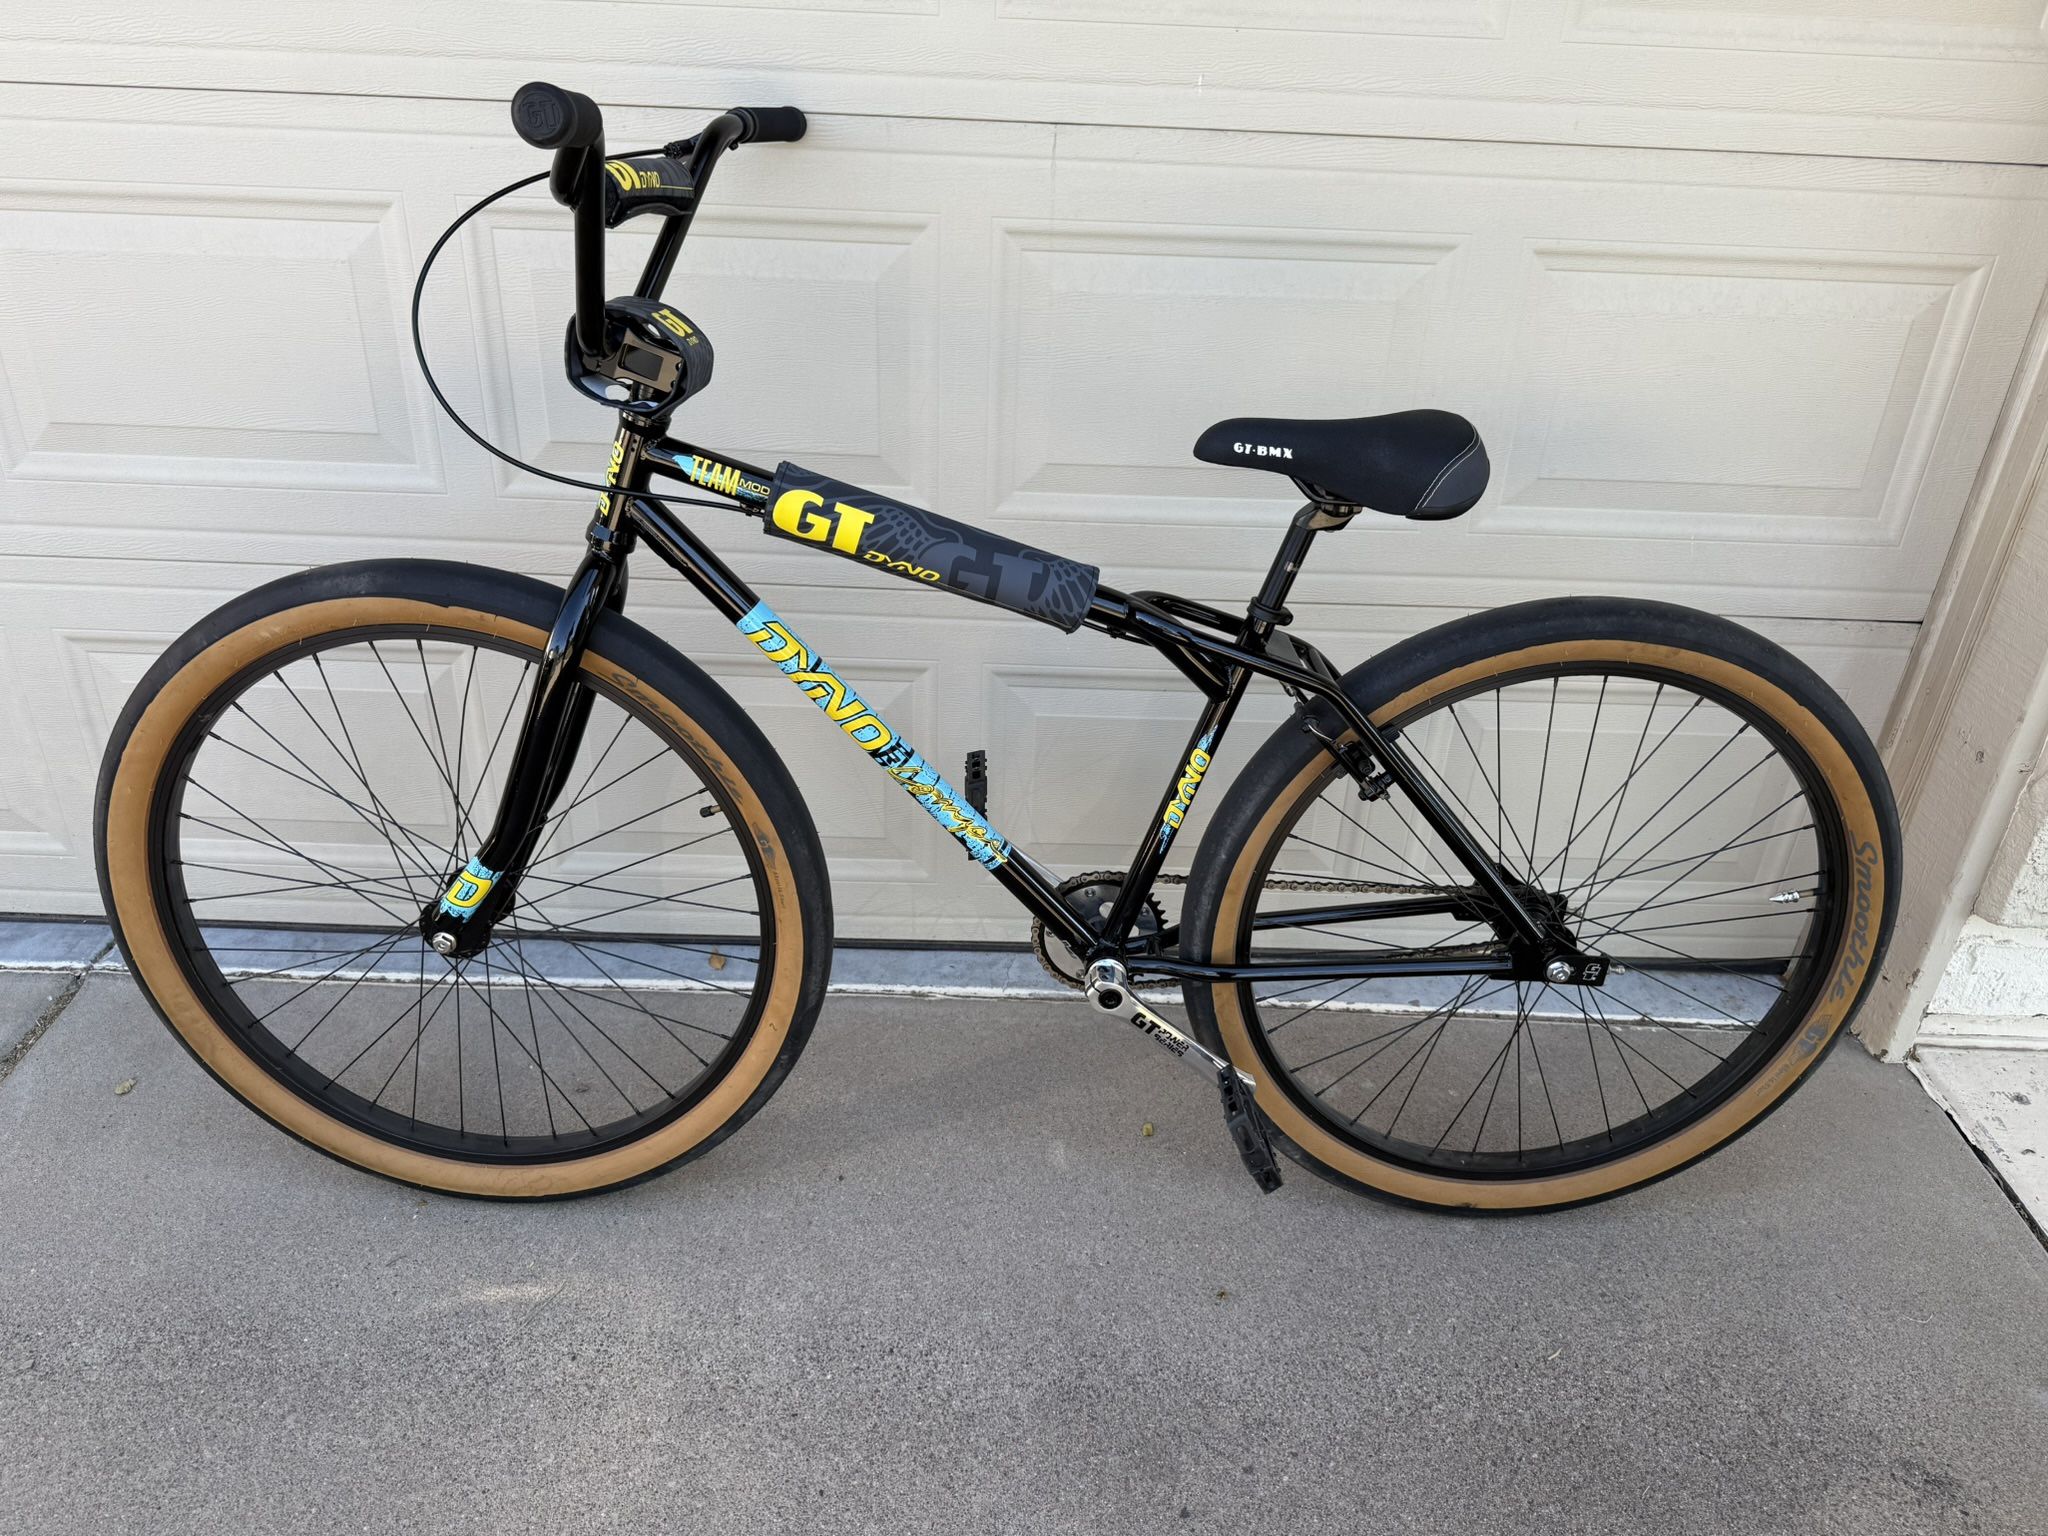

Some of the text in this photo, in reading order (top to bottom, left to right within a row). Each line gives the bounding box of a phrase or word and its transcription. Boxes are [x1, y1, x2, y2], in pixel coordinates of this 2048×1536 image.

[652, 308, 692, 338] GT
[690, 454, 741, 496] TEAM
[772, 489, 875, 556] GT
[863, 550, 941, 583] DYNO
[918, 541, 1044, 608] GT
[744, 620, 893, 751] DYNO
[1163, 748, 1211, 829] DYNO
[446, 870, 493, 908] D
[1829, 830, 1878, 1004] Smoothie
[1130, 1012, 1161, 1035] GT
